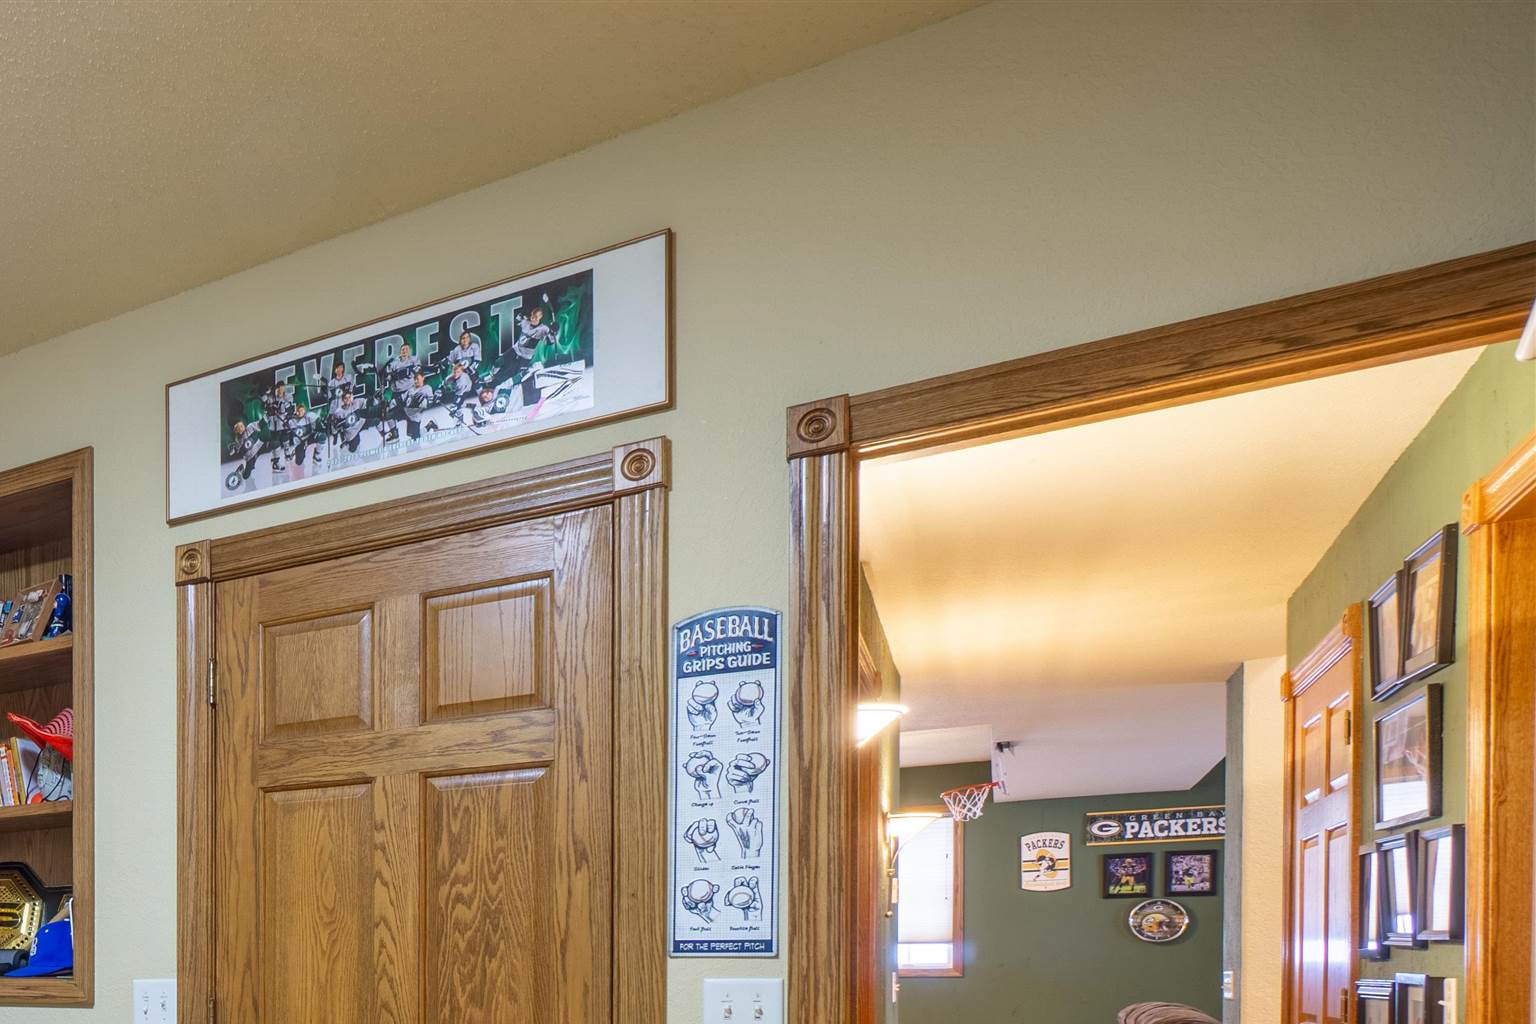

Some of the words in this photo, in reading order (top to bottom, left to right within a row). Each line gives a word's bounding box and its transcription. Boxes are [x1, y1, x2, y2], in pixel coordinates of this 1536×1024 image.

[679, 615, 774, 654] BASEBALL
[700, 641, 752, 657] PITCHING
[682, 657, 725, 673] GRIPS
[726, 652, 771, 669] GUIDE
[1129, 812, 1184, 821] GREEN
[1125, 817, 1225, 839] PACKERS
[1024, 838, 1066, 852] PACKERS
[679, 943, 694, 951] FOR
[695, 943, 709, 951] THE
[710, 942, 742, 951] PERFECT
[743, 942, 766, 951] PITCH
